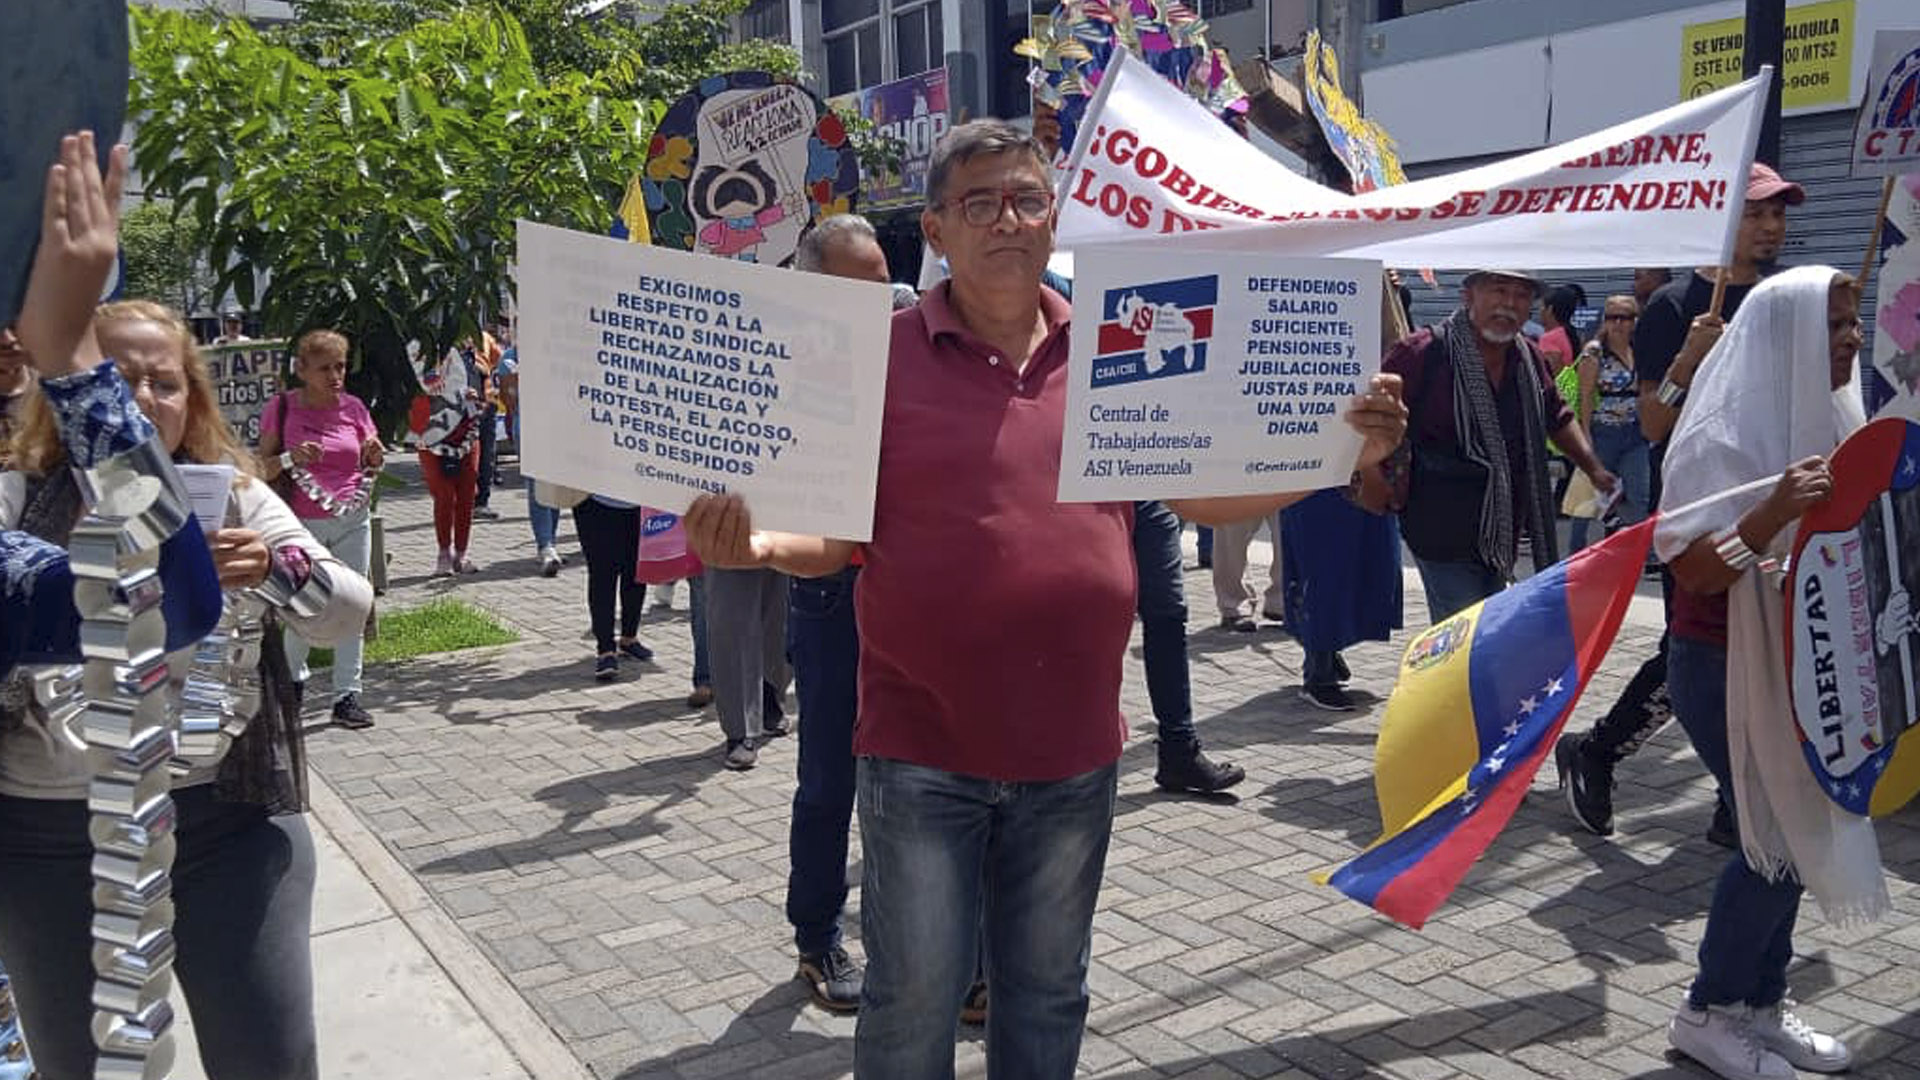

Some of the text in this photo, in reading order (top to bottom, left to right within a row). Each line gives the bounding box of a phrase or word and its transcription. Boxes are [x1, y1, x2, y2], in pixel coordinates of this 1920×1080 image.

[1693, 18, 1840, 56] SE VEND ALQUILA
[1694, 41, 1838, 77] ESTE LO 00 MTS2
[1781, 71, 1831, 90] -9006
[1864, 129, 1920, 157] CT
[1072, 168, 1154, 229] LOS
[1487, 179, 1728, 216] DEFIENDEN!
[639, 276, 742, 309] EXIGIMOS
[1247, 277, 1358, 295] DEFENDEMOS
[617, 293, 763, 334] RESPETO A LA
[1131, 305, 1154, 332] ASI
[1267, 299, 1339, 316] SALARIO
[589, 307, 793, 360] LIBERTAD SINDICAL
[1247, 340, 1356, 359] PENSIONES y
[602, 331, 776, 379] RECHAZAMOS LA
[1239, 361, 1362, 376] JUBILACIONES
[596, 351, 780, 400] CRIMINALIZACIÓN
[1242, 381, 1357, 396] JUSTAS PARA
[603, 372, 770, 418] DE LA HUELGA Y
[1257, 402, 1338, 416] UNA VIDA
[578, 385, 798, 445] PROTESTA, EL ACOSO,
[1090, 403, 1170, 422] Central de
[1267, 421, 1320, 436] DIGNA
[590, 408, 783, 461] LA PERSECUCIÓN Y
[1086, 431, 1213, 453] Trabajadores/as
[613, 432, 755, 476] LOS DESPIDOS
[1083, 458, 1193, 477] ASI Venezuela
[1244, 459, 1324, 474] @CentralASI
[635, 462, 728, 495] @CentralASI
[1841, 541, 1879, 729] LIBERTAD
[1803, 573, 1846, 767] LIBERTAD
